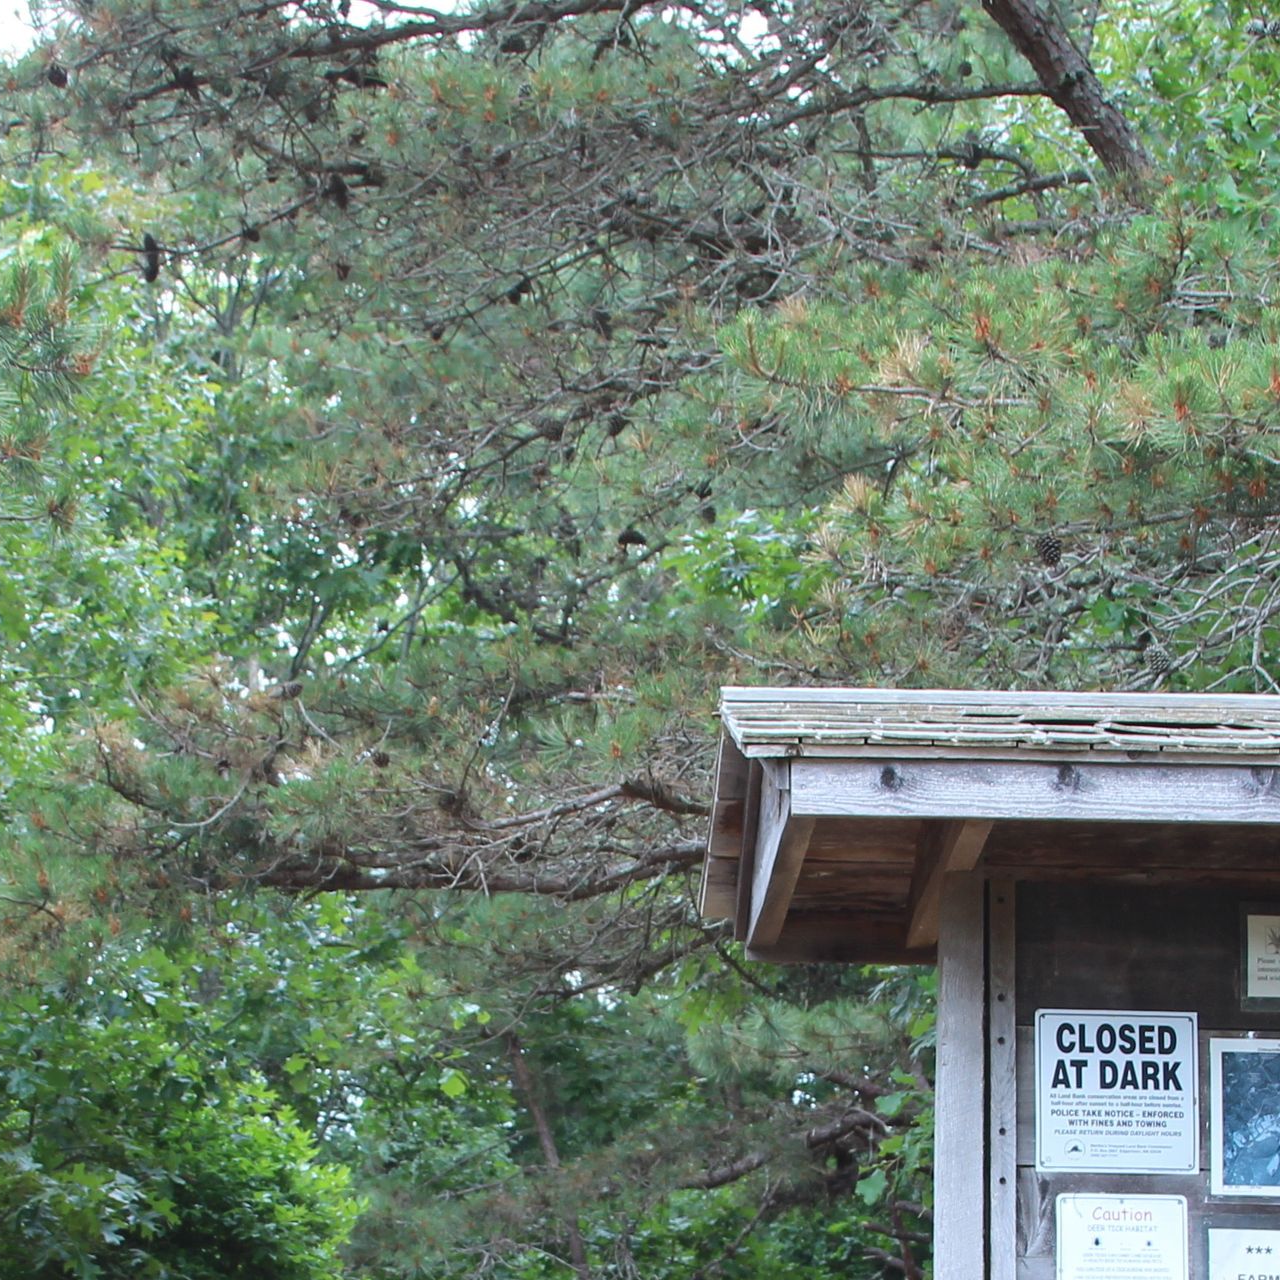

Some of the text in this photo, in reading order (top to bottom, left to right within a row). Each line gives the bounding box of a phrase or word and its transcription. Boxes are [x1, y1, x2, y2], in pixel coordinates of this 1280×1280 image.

[1056, 1023, 1177, 1055] CLOSED
[1052, 1060, 1182, 1091] AT DARK
[1092, 1207, 1152, 1221] Caution
